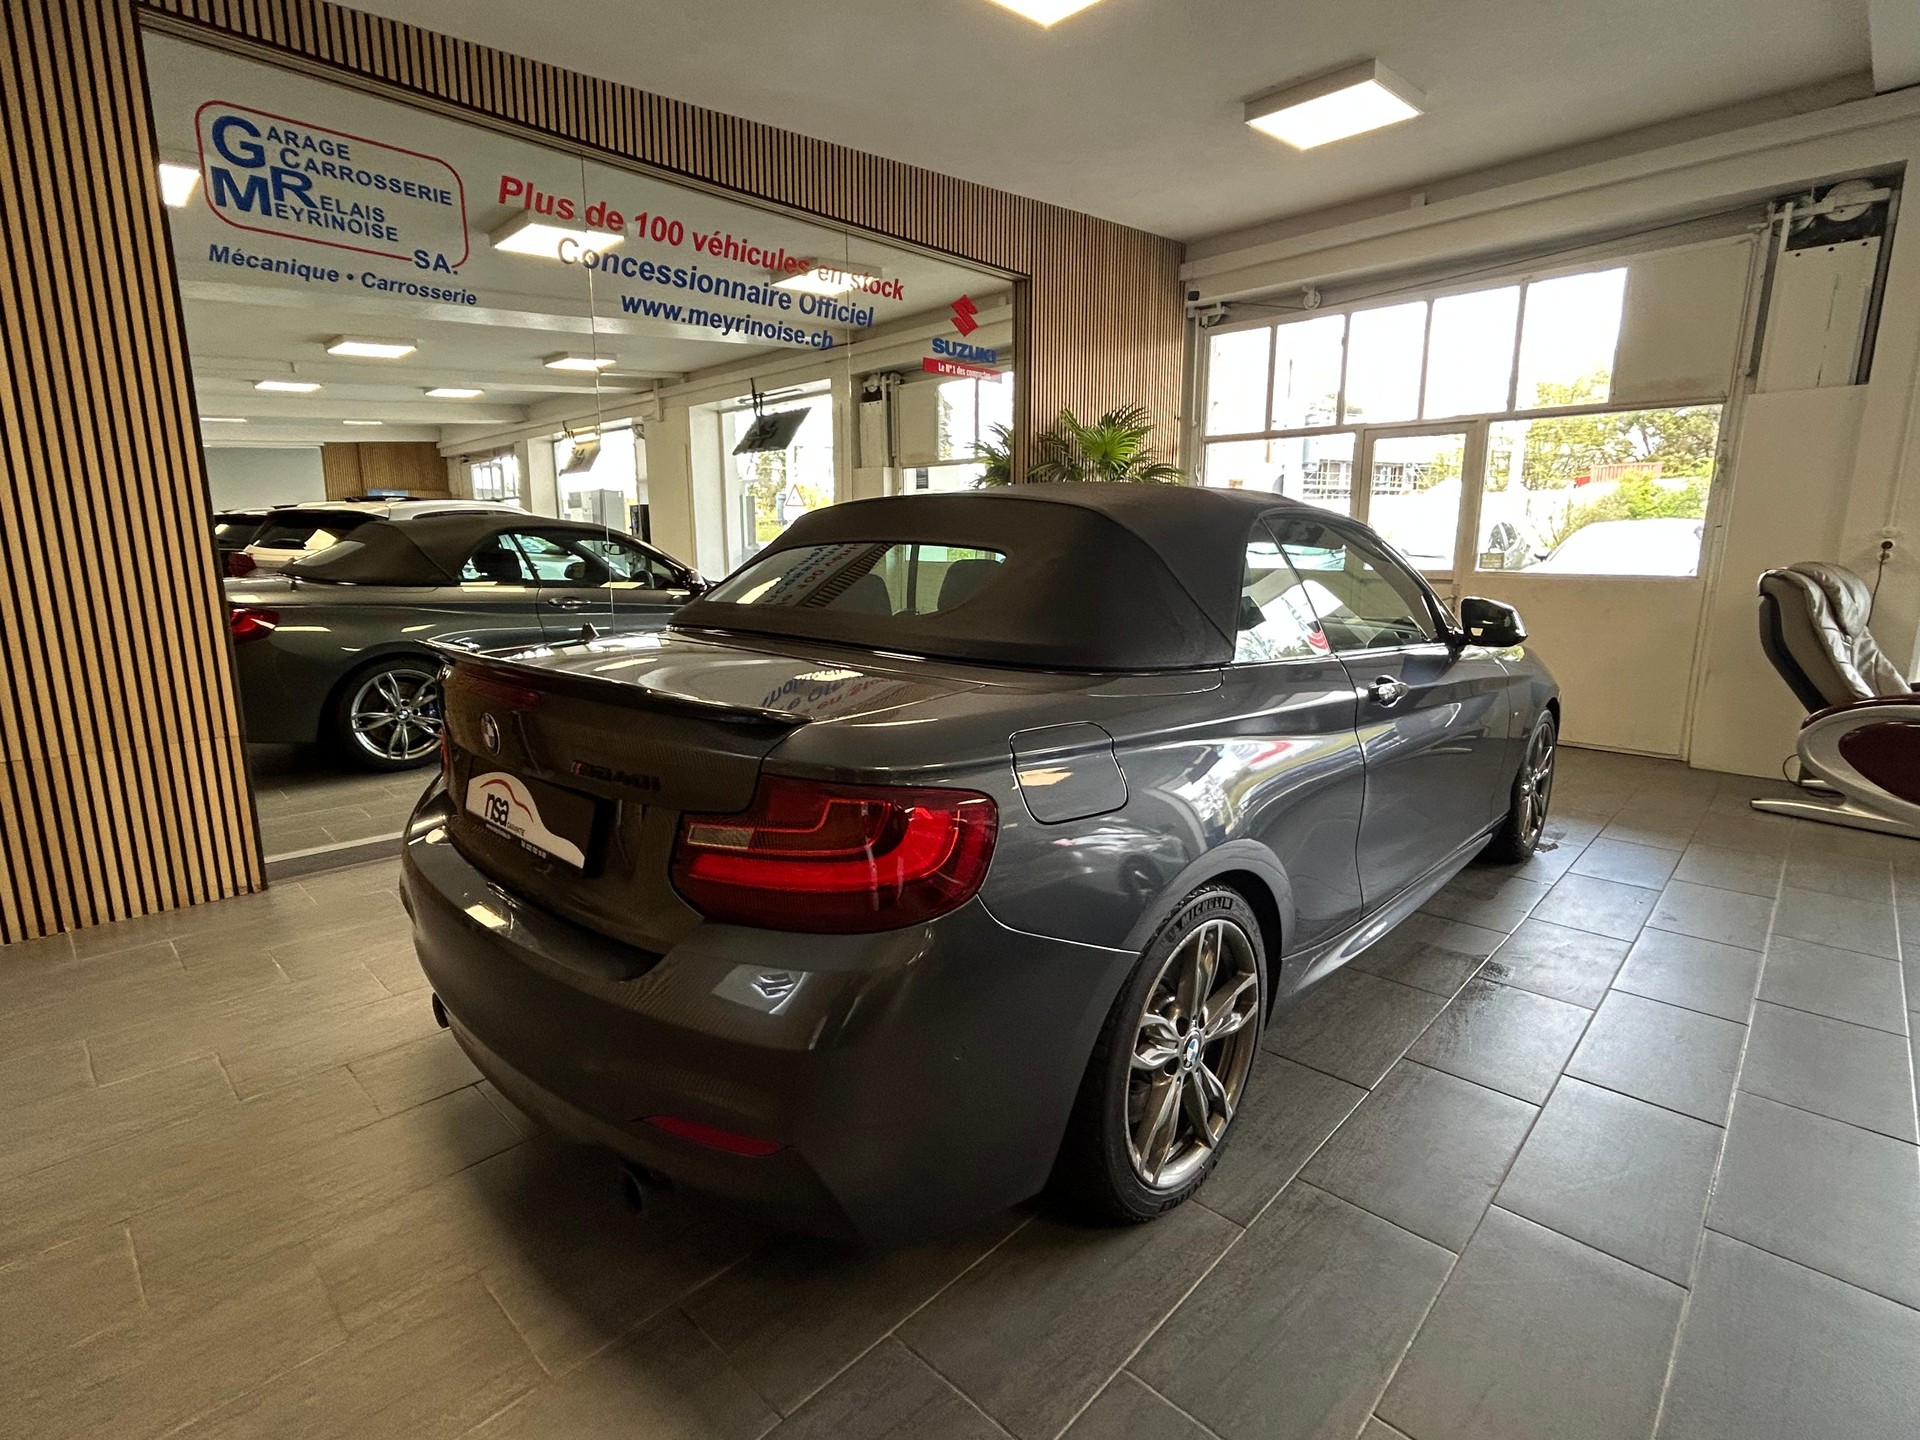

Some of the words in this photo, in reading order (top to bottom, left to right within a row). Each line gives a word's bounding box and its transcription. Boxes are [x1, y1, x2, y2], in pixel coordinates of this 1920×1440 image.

[211, 115, 351, 169] GARAGE
[210, 165, 399, 242] MEYRINOISE
[269, 165, 386, 223] RELAIS
[279, 149, 453, 206] CARROSSERIE
[498, 175, 575, 221] Plus
[584, 201, 625, 232] de
[634, 211, 684, 246] 100
[692, 231, 811, 276] véhicules
[817, 264, 843, 286] en
[849, 271, 905, 301] stock
[208, 244, 340, 282] Mécanique
[360, 272, 477, 306] Carrosserie
[557, 237, 792, 311] Concessionnaire
[799, 292, 874, 328] Officiel
[621, 294, 834, 349] www.meyrinoise.ch
[932, 337, 996, 364] SUZUKI
[484, 793, 509, 827] nsa
[1180, 896, 1233, 928] MICHELIN
